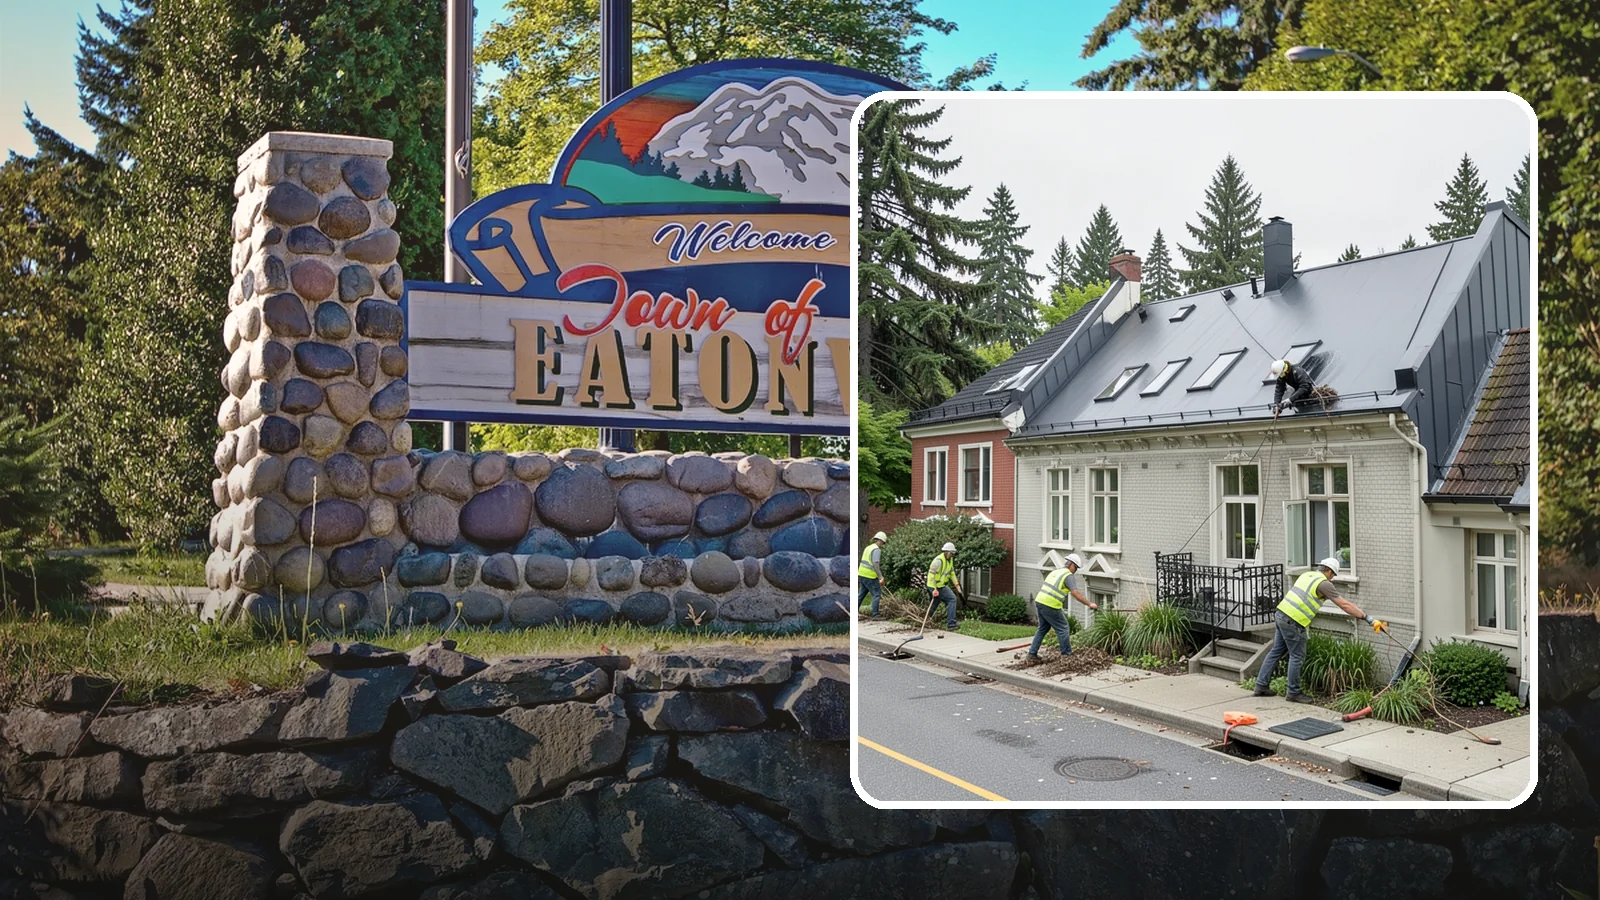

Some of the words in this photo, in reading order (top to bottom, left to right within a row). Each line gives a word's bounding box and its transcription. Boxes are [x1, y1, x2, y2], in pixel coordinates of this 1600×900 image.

[654, 221, 837, 263] Welcome
[556, 263, 737, 336] Town
[764, 278, 826, 365] of
